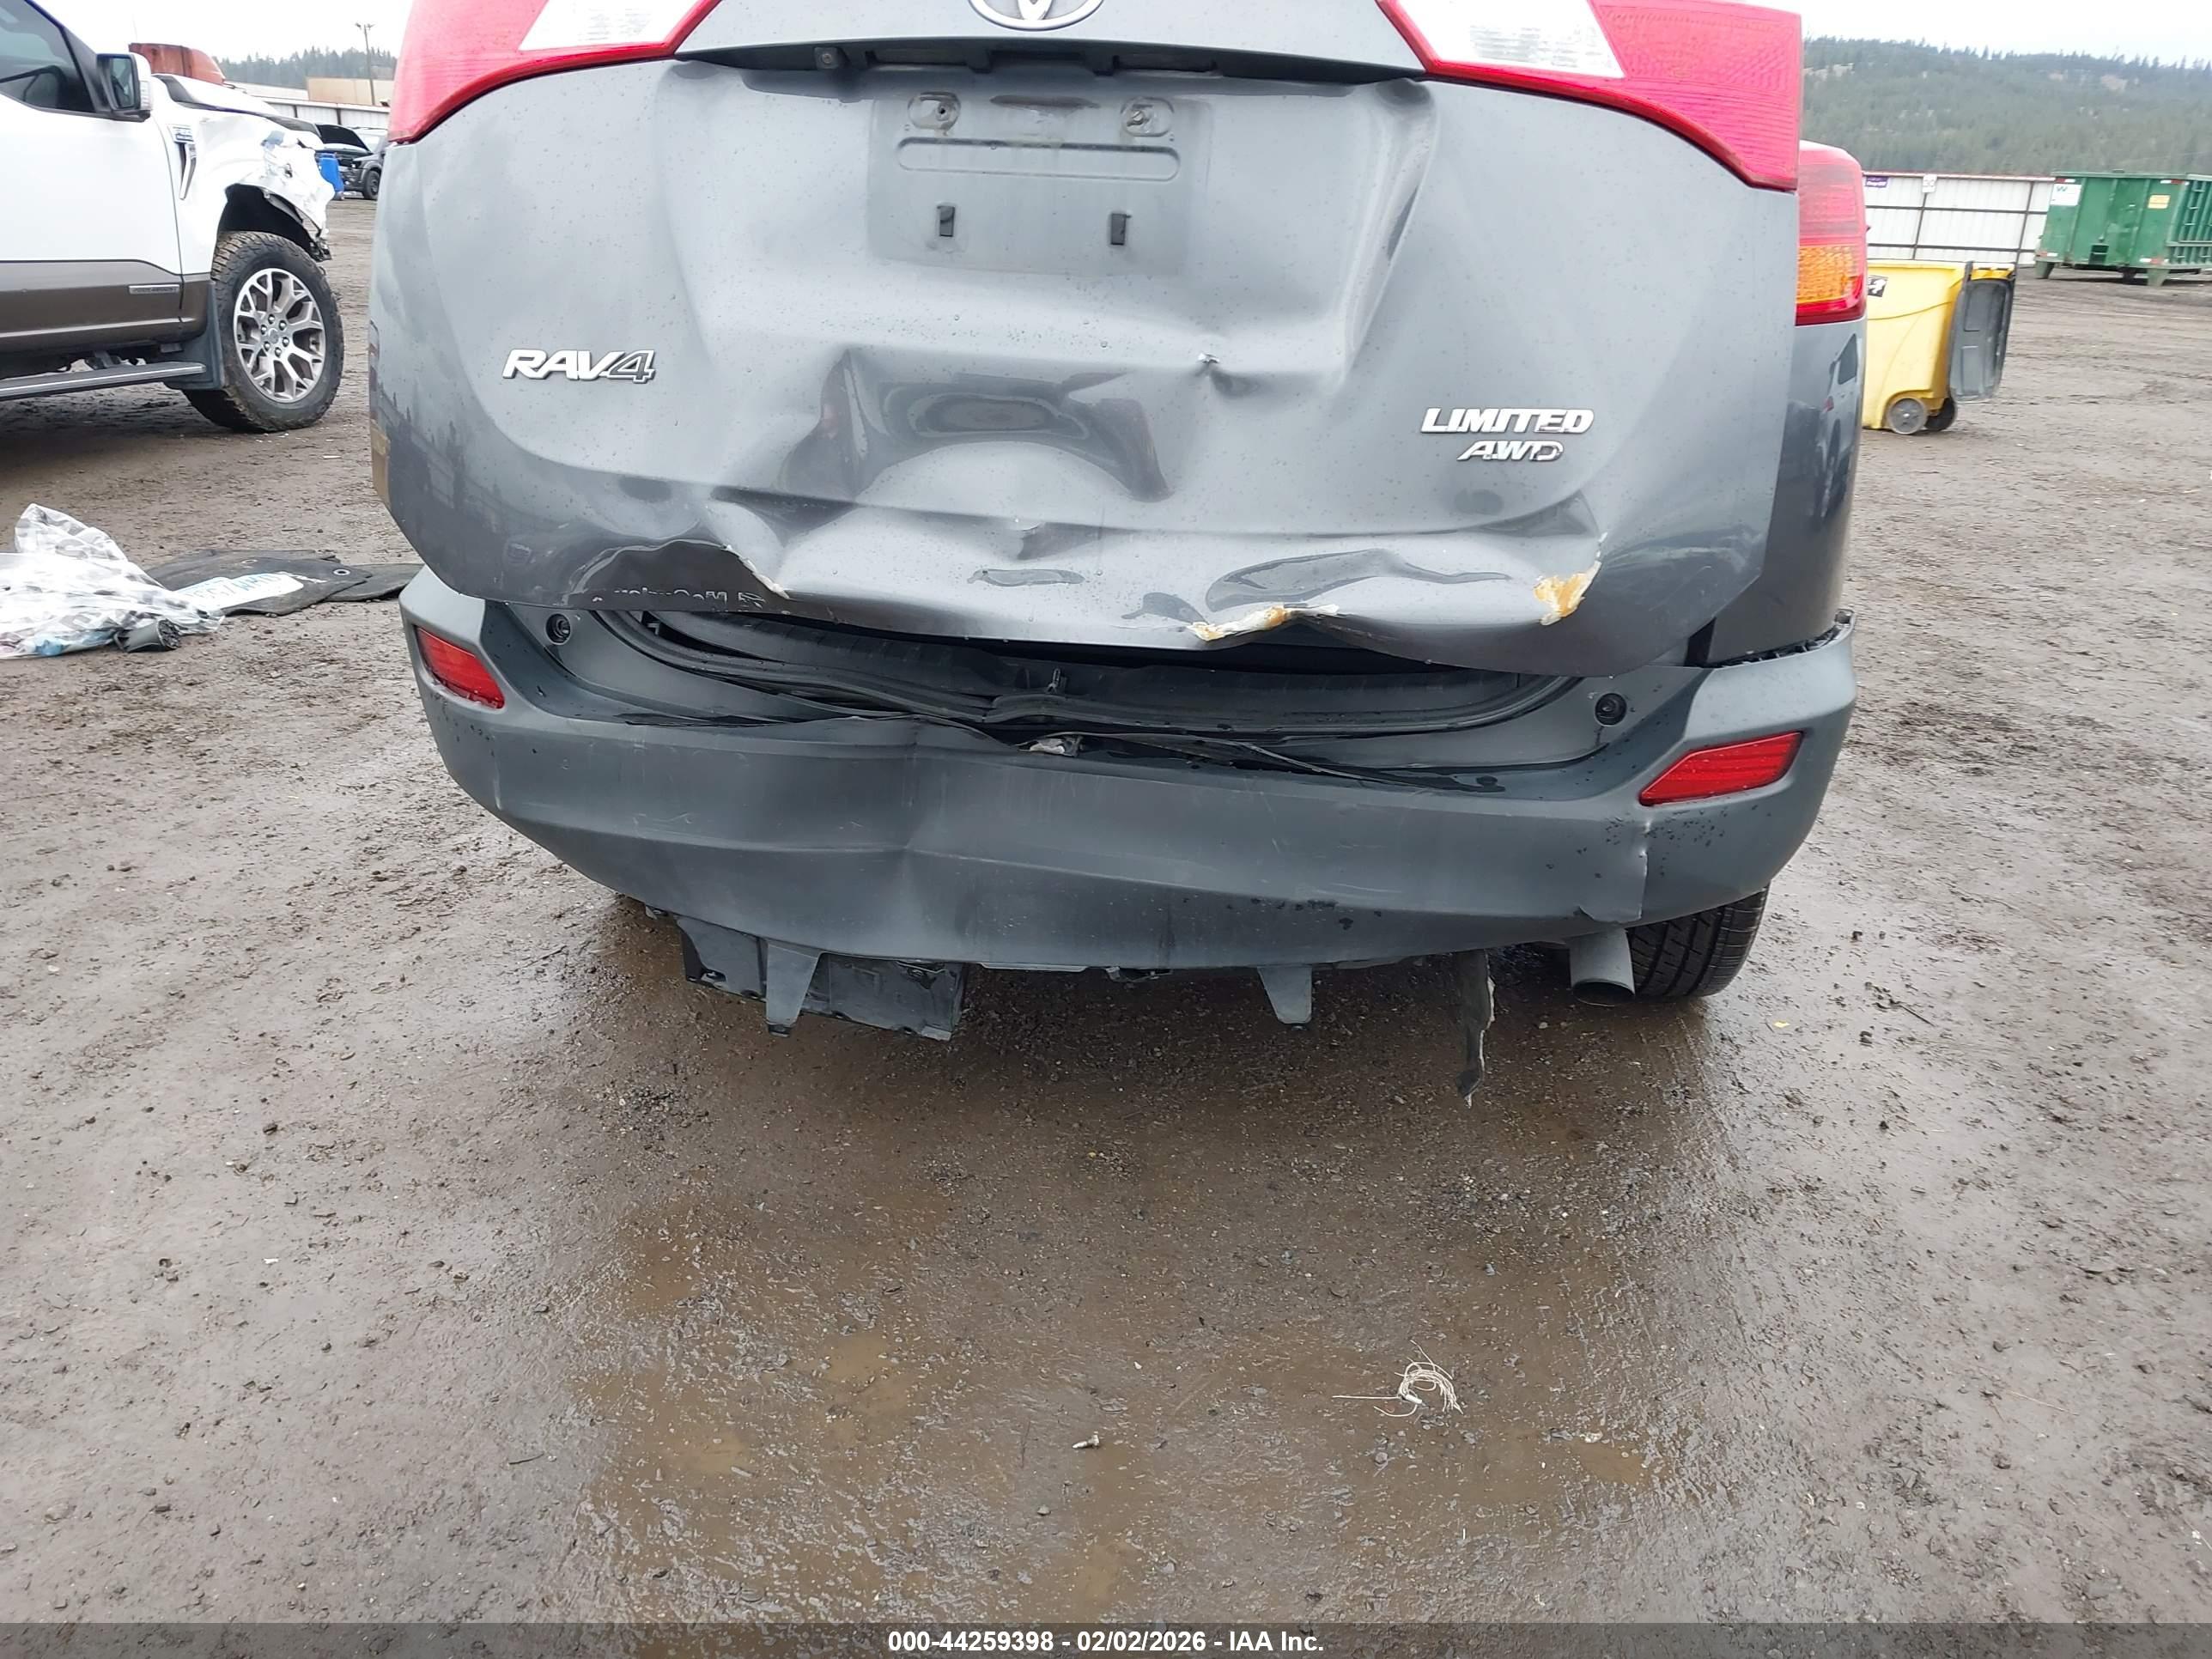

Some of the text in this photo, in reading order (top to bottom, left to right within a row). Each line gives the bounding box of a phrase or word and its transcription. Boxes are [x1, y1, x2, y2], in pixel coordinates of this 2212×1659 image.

[502, 349, 655, 384] RAV4
[1420, 407, 1595, 434] LIMITED
[1456, 440, 1565, 461] AWD
